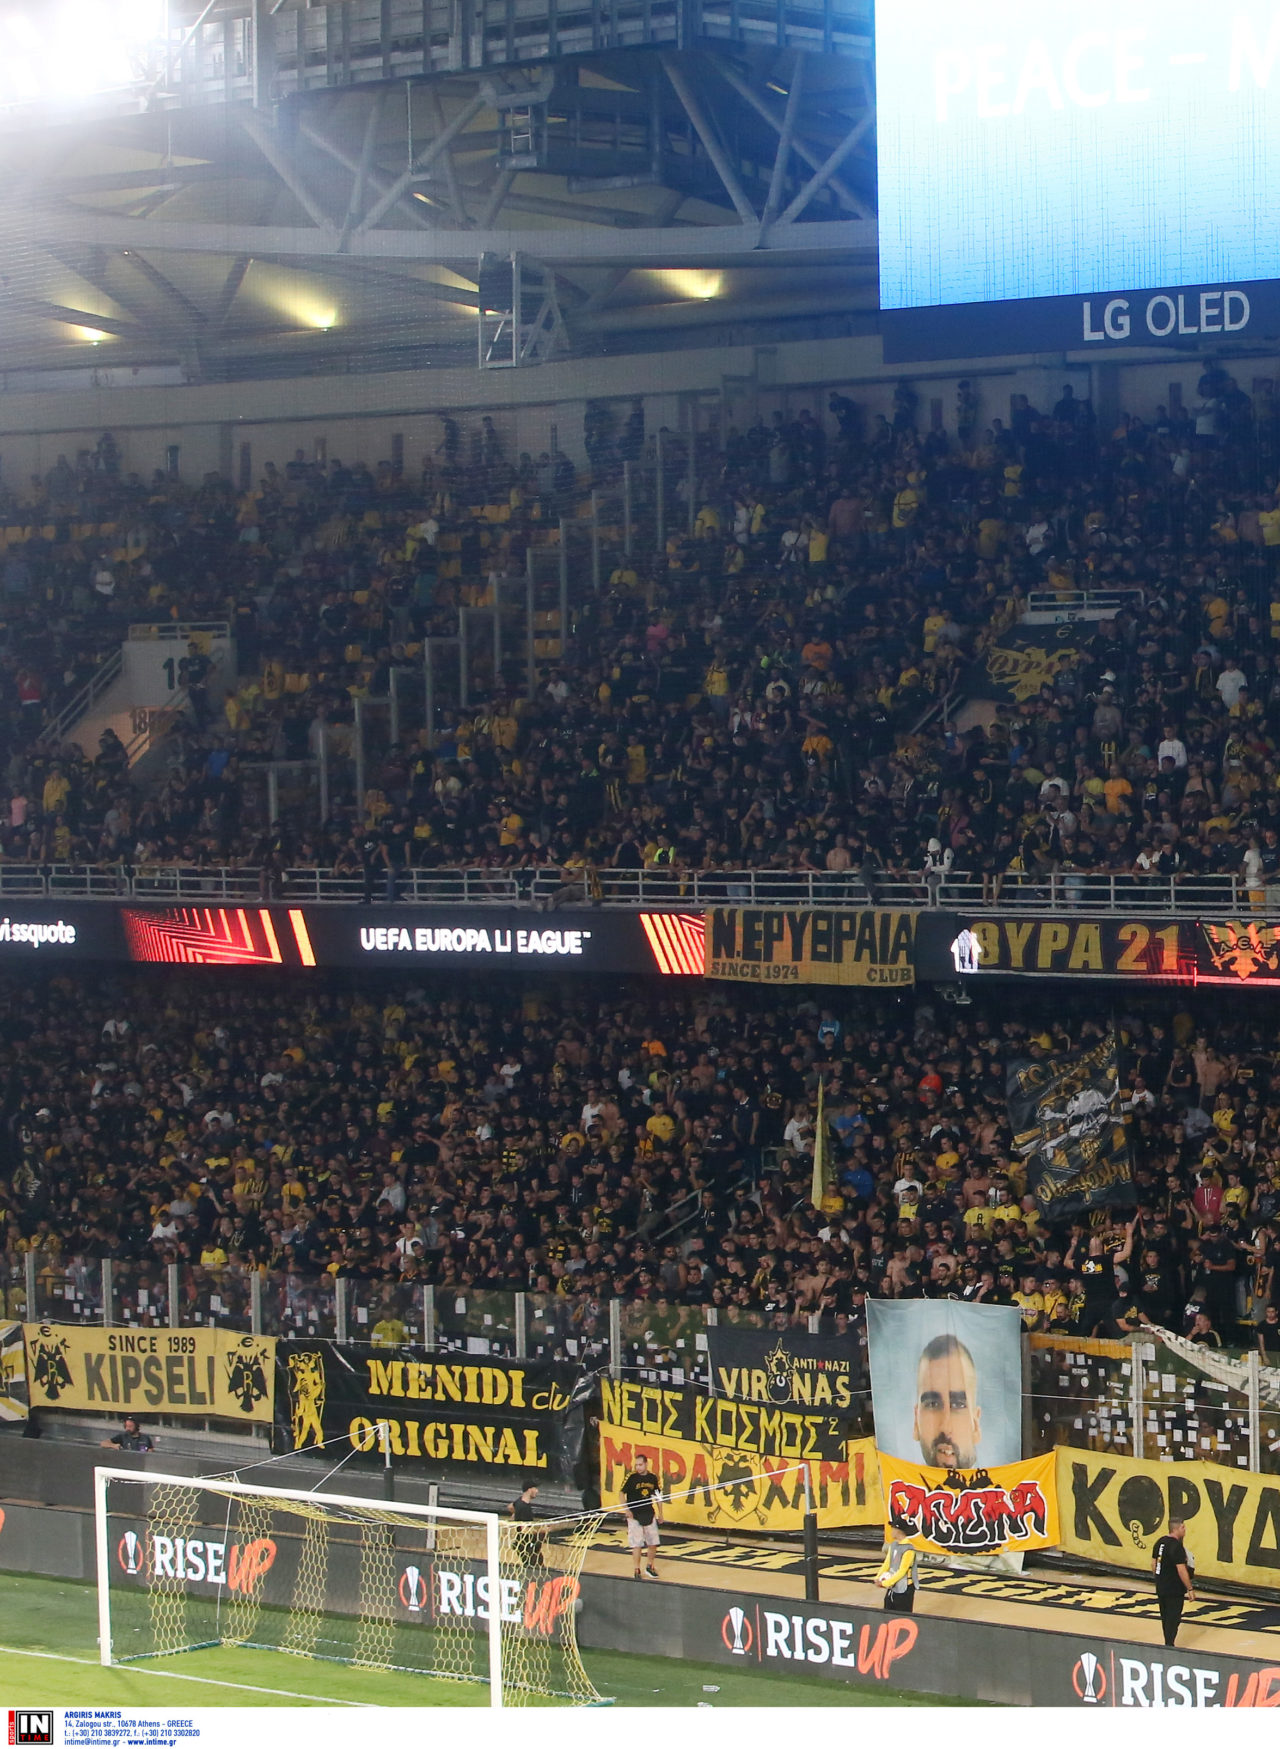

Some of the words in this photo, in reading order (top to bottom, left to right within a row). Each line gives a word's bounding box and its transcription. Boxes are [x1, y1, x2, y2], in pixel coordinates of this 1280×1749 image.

[933, 28, 1150, 122] PEACE
[1082, 301, 1131, 341] LG
[1146, 290, 1250, 336] OLED
[360, 928, 412, 950] UEFA
[415, 929, 492, 952] EUROPA
[1116, 924, 1180, 971] 21
[711, 962, 760, 979] SINCE
[764, 965, 799, 980] 1974
[866, 967, 912, 983] CLUB
[108, 1334, 158, 1353] SINCE
[167, 1336, 196, 1354] 1989
[792, 1357, 817, 1370] ANTI
[825, 1359, 850, 1373] NAZI
[84, 1352, 216, 1405] KIPSELI
[366, 1359, 527, 1408] MENIDI
[349, 1416, 548, 1468] ORIGINAL
[600, 1377, 684, 1438] ΝΕΟΣ
[694, 1395, 825, 1459] ΚΟΣΜΟΣ
[152, 1535, 227, 1585] RISE
[228, 1538, 277, 1595] UP
[438, 1570, 522, 1623] RISE
[523, 1576, 581, 1635] UP
[764, 1611, 855, 1667] RISE
[857, 1617, 919, 1679] UP
[1119, 1658, 1221, 1708] RISE
